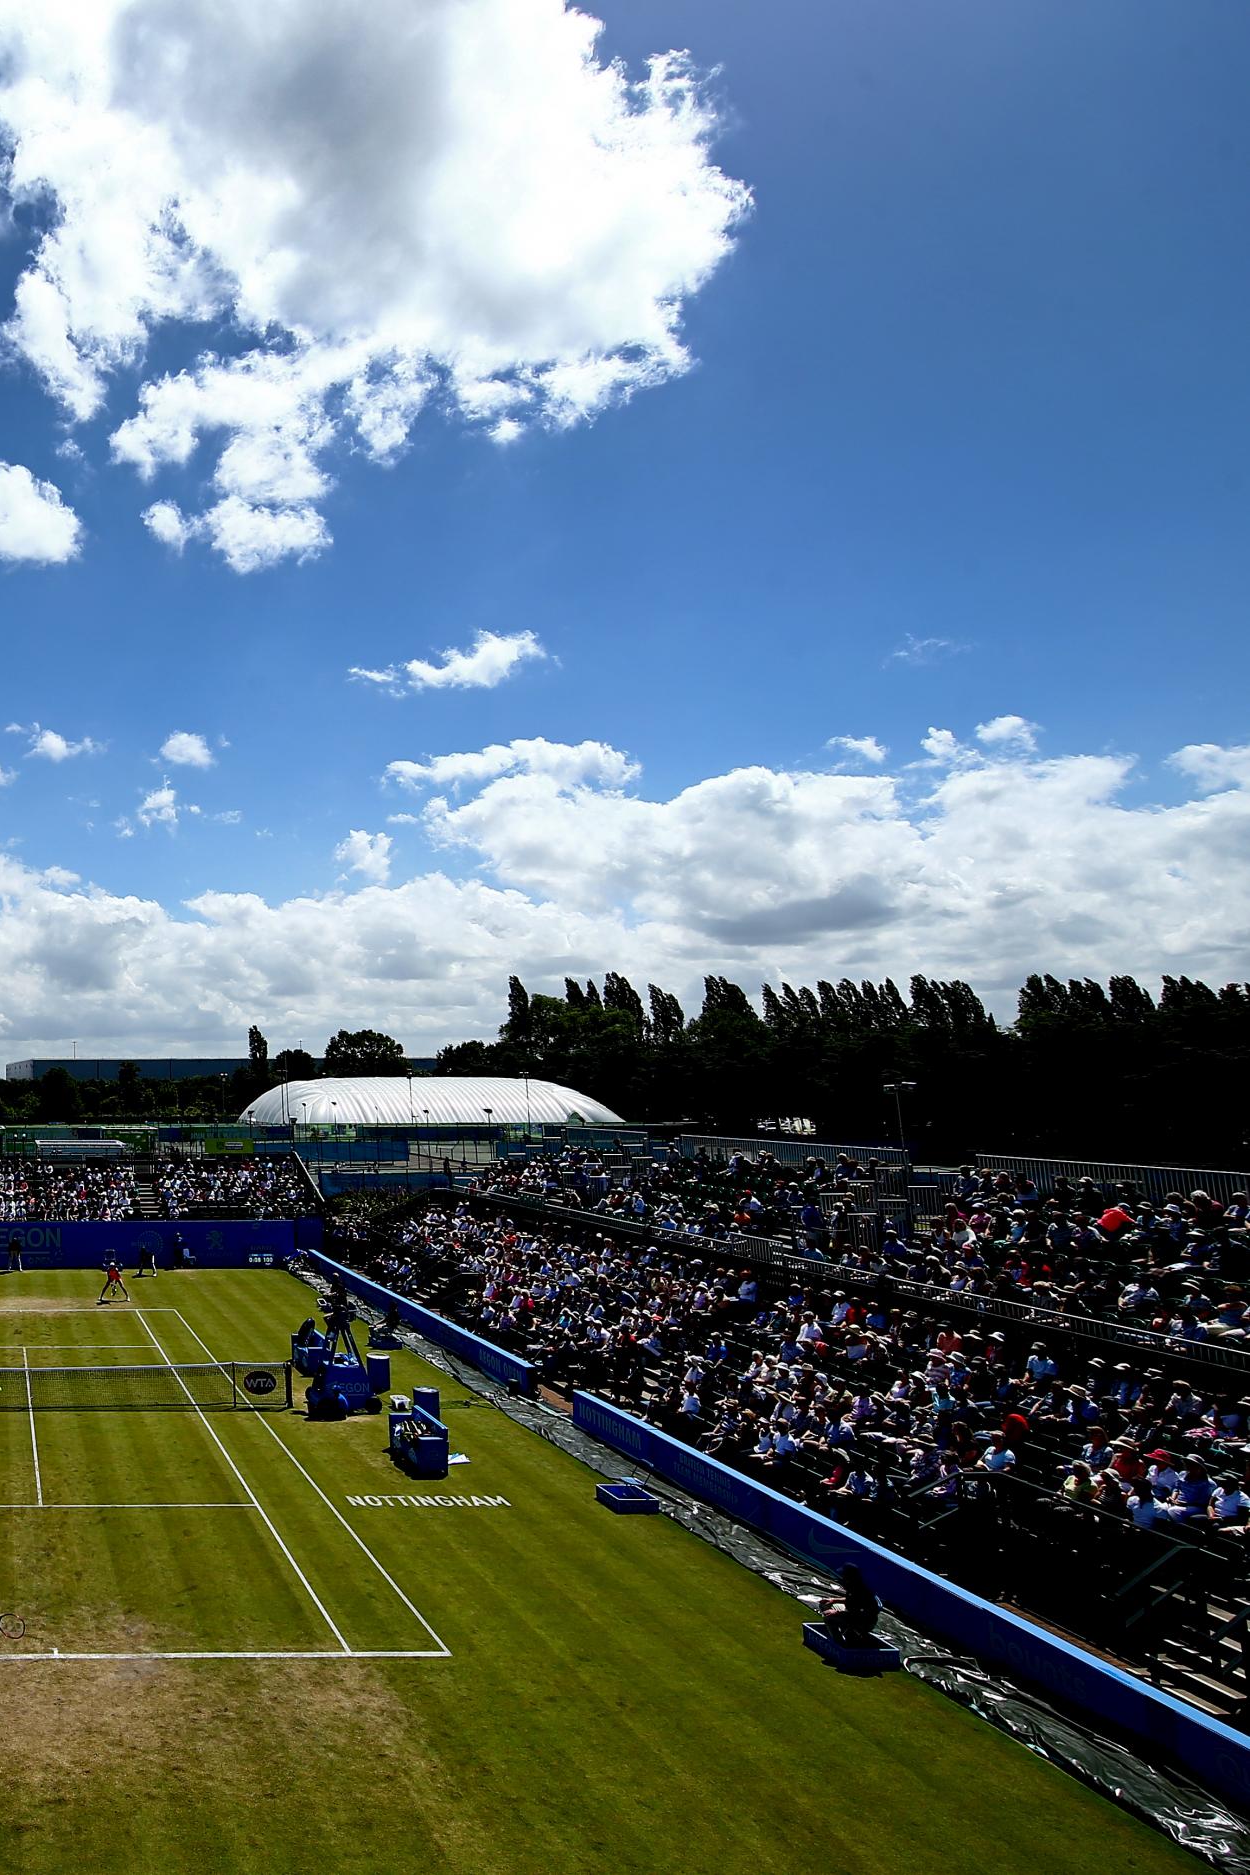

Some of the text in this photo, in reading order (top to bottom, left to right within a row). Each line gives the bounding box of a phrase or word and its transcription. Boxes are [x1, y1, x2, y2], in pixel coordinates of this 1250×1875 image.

[245, 1378, 274, 1388] WTA
[338, 1382, 370, 1393] EGON
[579, 1402, 641, 1450] NOTTINGHAM
[345, 1495, 512, 1506] NOTTINGHAM
